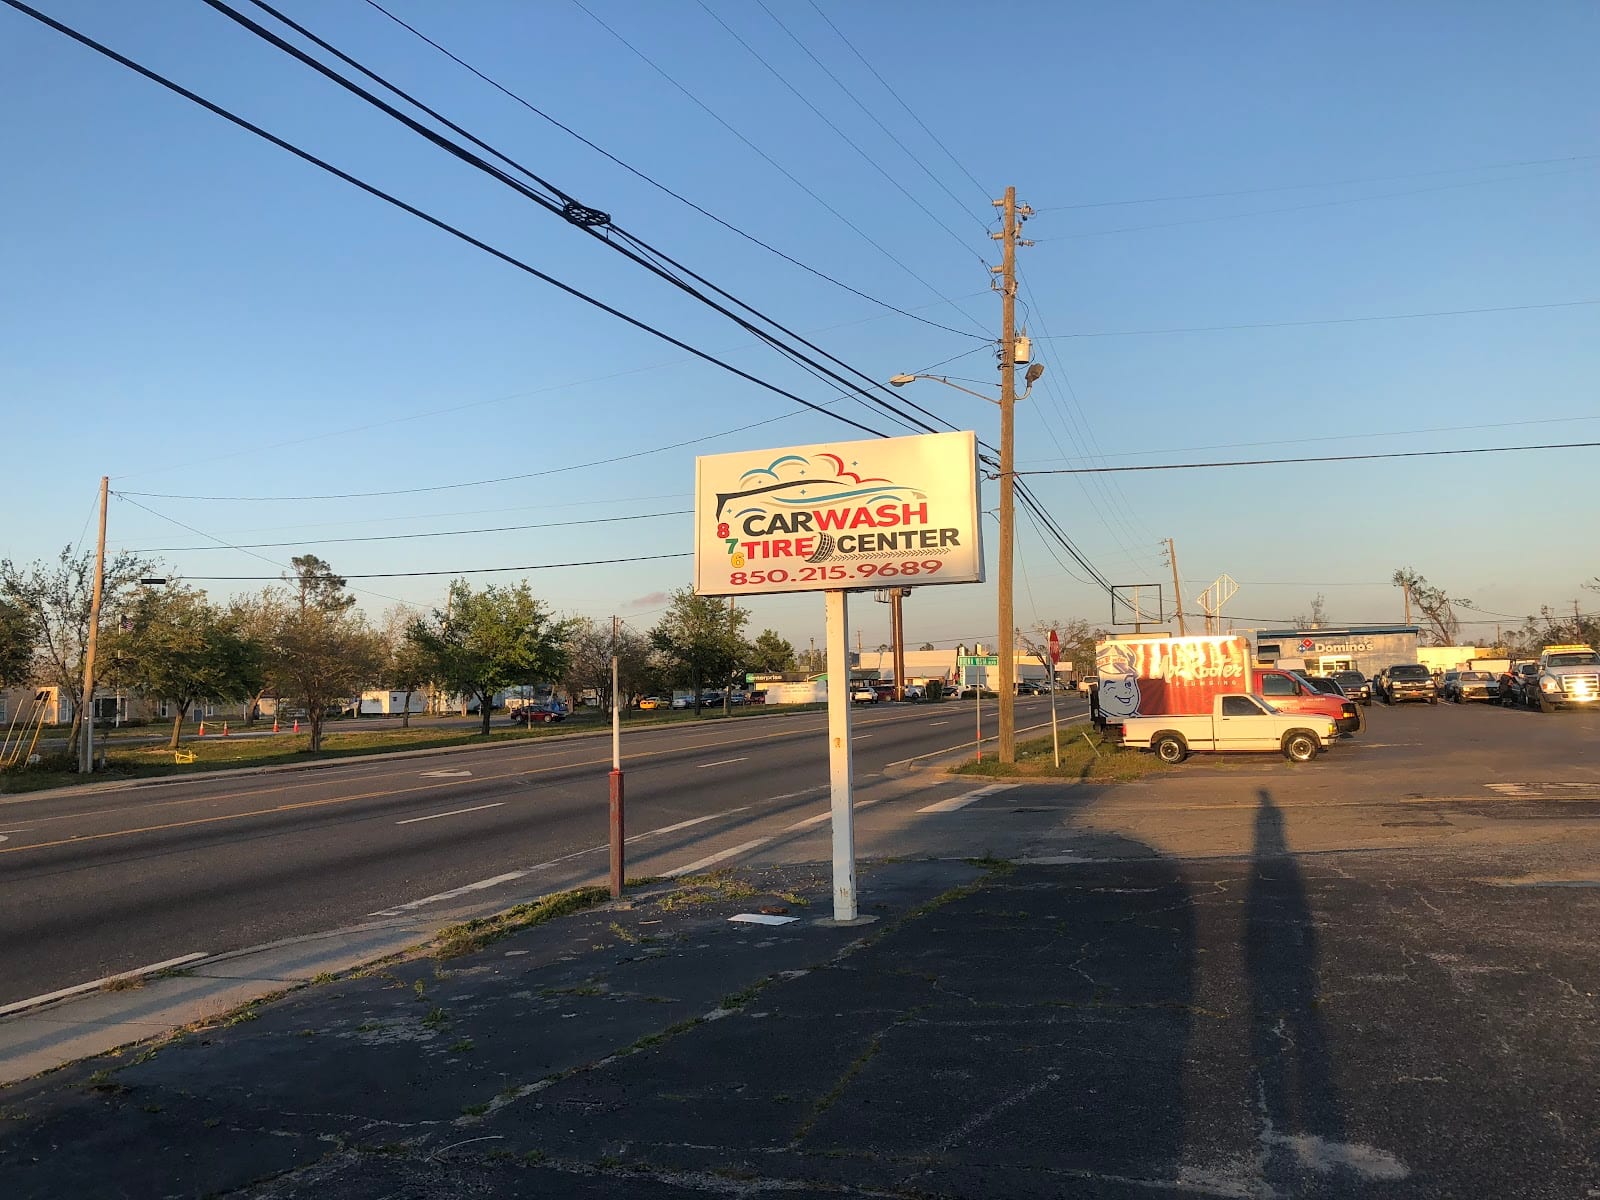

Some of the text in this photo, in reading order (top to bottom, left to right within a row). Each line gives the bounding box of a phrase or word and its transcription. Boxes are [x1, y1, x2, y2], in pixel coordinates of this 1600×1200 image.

[743, 502, 928, 537] CARWASH
[741, 528, 961, 560] TIRE CENTER
[730, 559, 943, 586] 850.215.9689
[1314, 639, 1374, 653] Domino's
